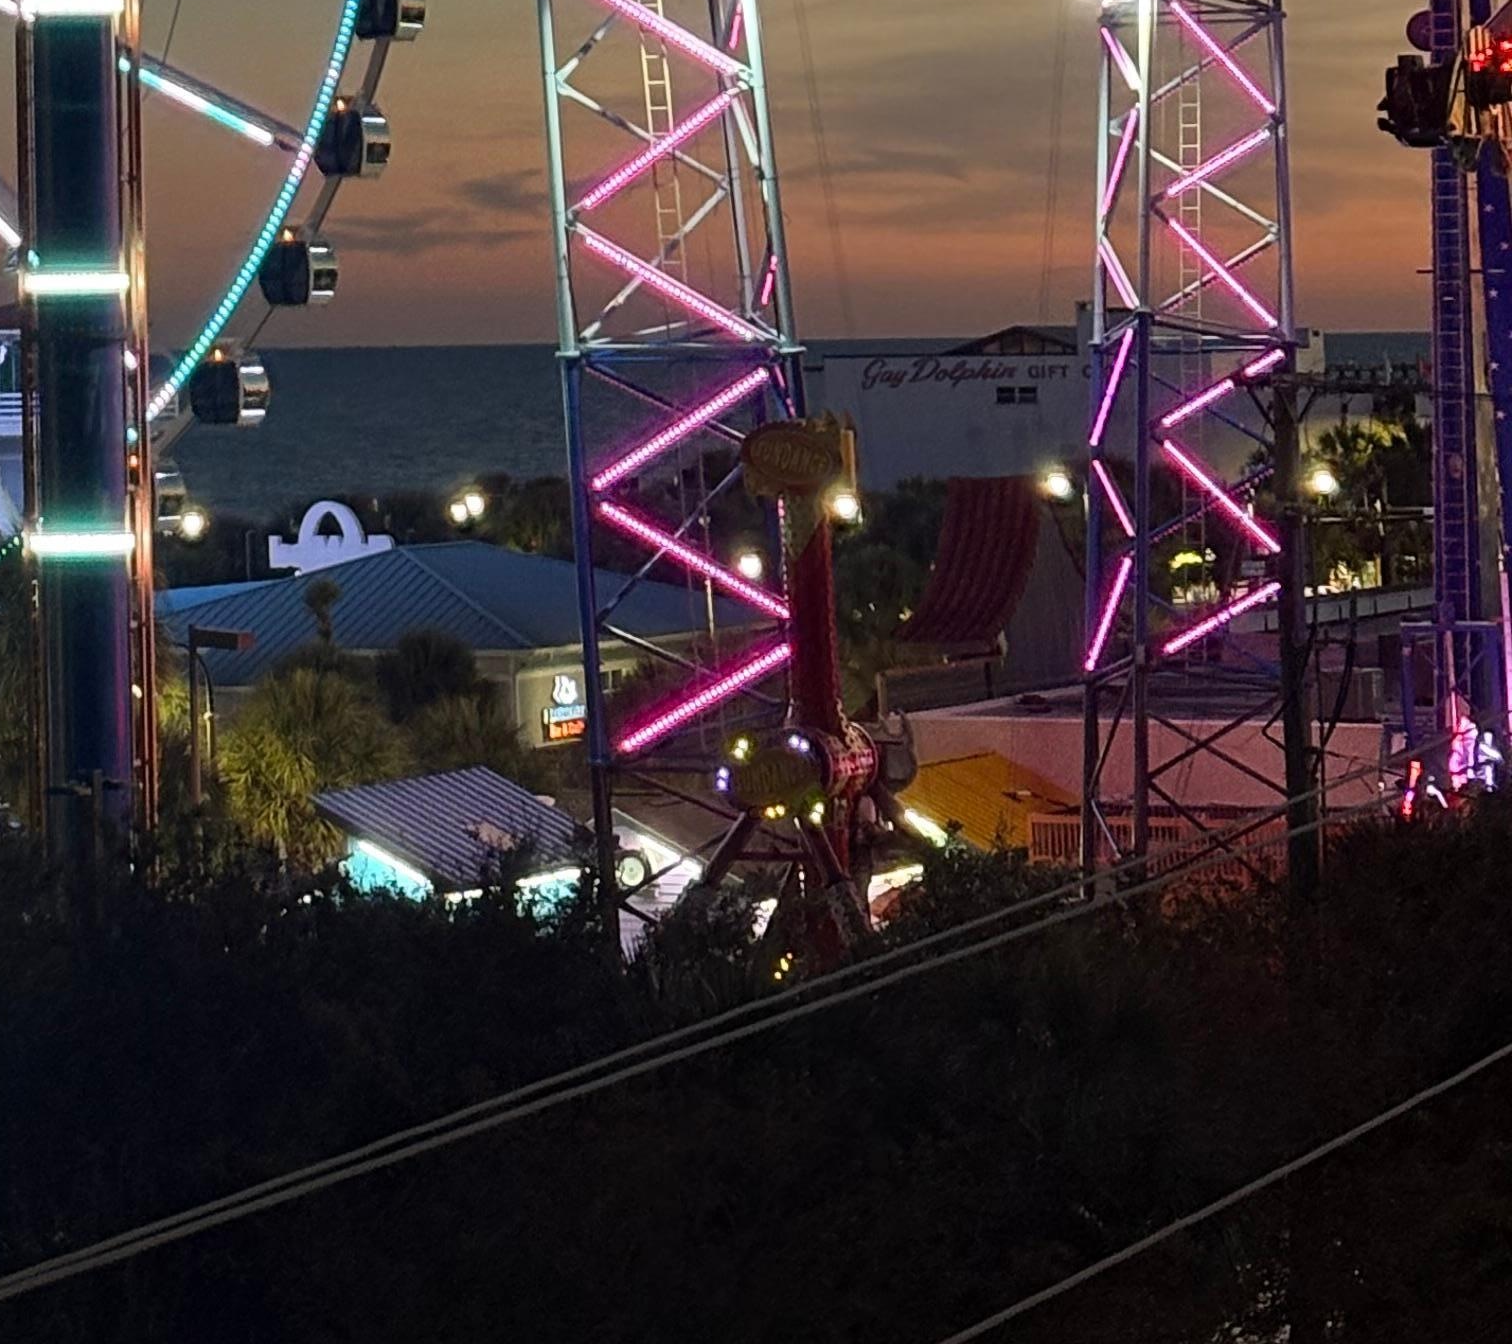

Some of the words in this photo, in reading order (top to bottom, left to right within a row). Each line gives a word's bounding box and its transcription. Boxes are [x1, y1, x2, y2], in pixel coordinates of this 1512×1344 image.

[862, 357, 906, 389] Gay
[910, 357, 1017, 387] Dolphin
[1028, 364, 1069, 379] GIFT
